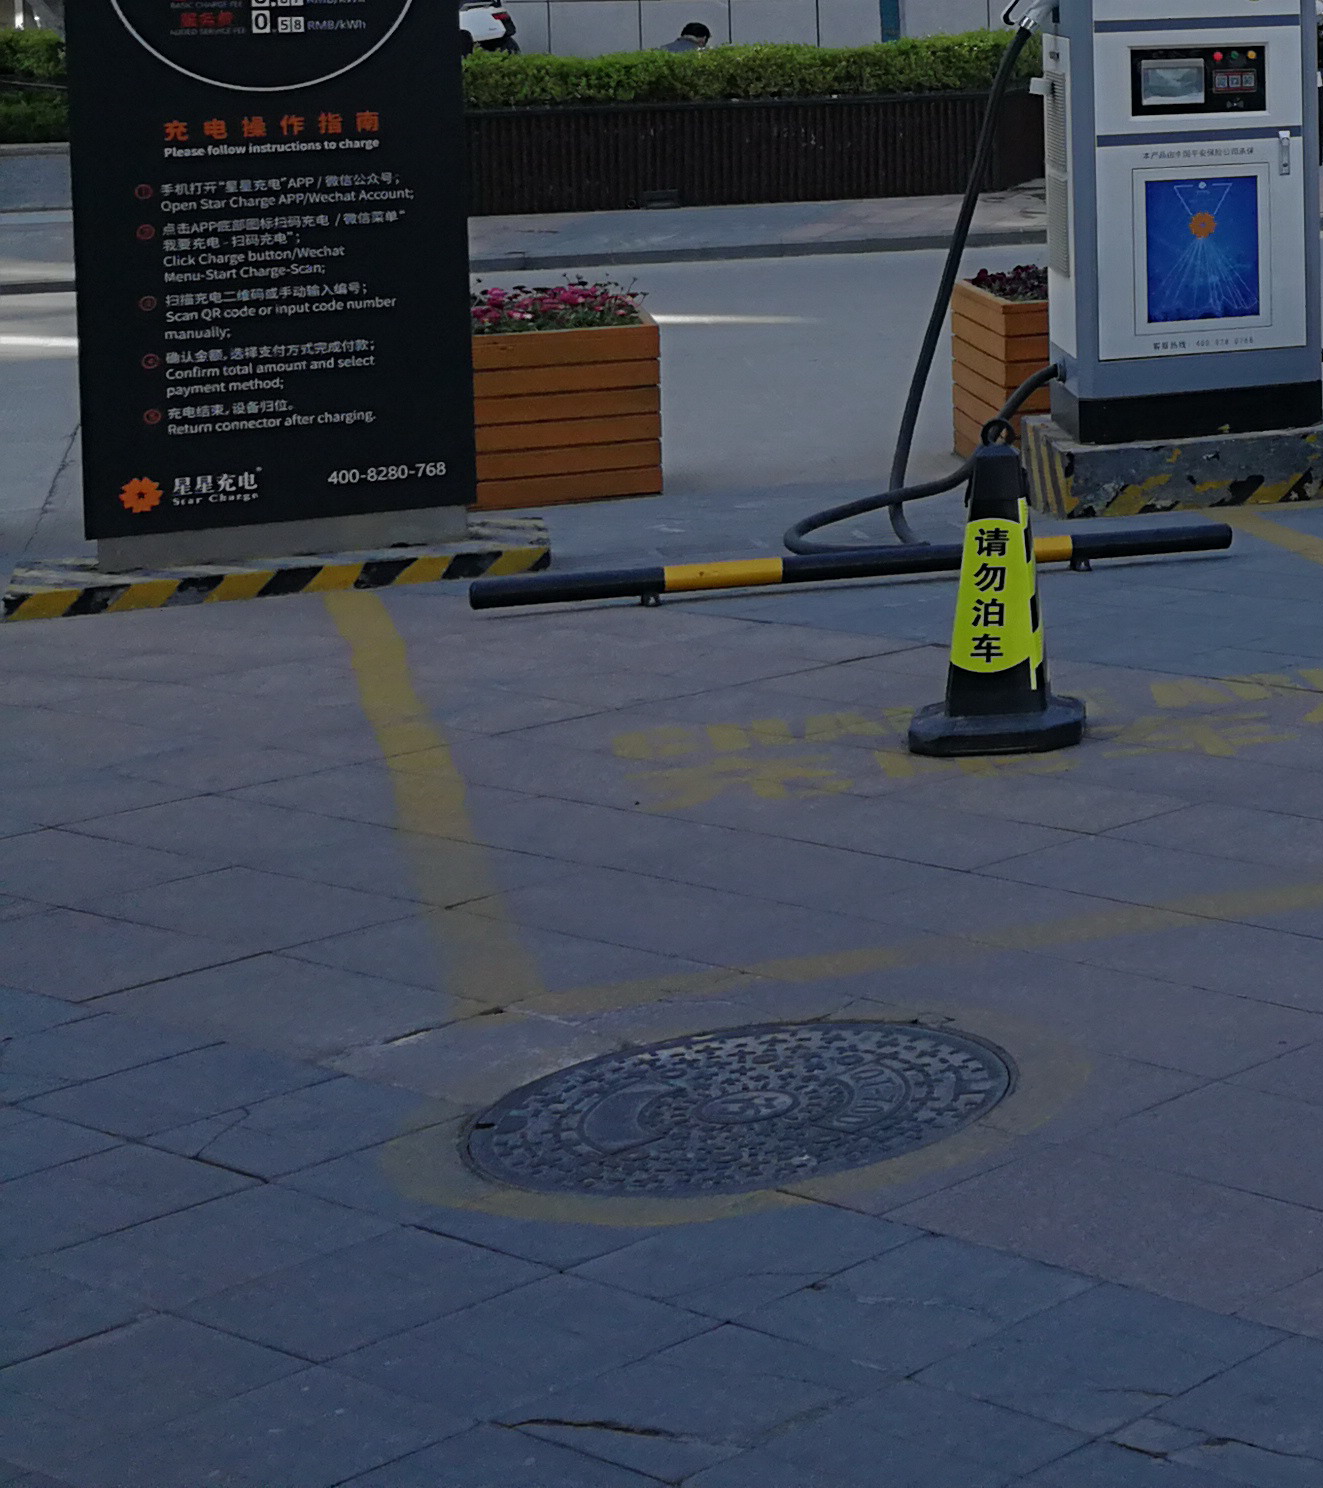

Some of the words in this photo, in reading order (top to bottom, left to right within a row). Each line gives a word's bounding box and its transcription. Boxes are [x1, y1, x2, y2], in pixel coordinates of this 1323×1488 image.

[307, 19, 366, 30] RMB/kWh
[163, 110, 380, 142] 充电操作指南
[164, 147, 205, 158] Please
[207, 144, 246, 155] follow
[249, 140, 322, 154] instructions
[324, 141, 337, 150] to
[339, 139, 380, 150] charge
[161, 199, 198, 213] Open
[200, 197, 227, 210] Star
[229, 195, 276, 209] Charge
[278, 190, 356, 206] APP/Wechat
[358, 188, 415, 202] Account;
[163, 254, 196, 267] Click
[198, 252, 246, 265] Charge
[247, 245, 345, 262] button/Wechat
[164, 268, 237, 283] Menu-Start
[239, 263, 326, 279] Charge-Scan;
[165, 311, 199, 323] Scan
[201, 307, 221, 321] QR
[223, 305, 256, 317] code
[258, 306, 273, 316] or
[275, 303, 310, 316] input
[312, 298, 344, 311] code
[346, 296, 397, 309] number
[164, 326, 232, 340] manually;
[165, 366, 220, 380] Confirm
[222, 362, 253, 376] total
[255, 360, 308, 374] amount
[309, 357, 335, 370] and
[337, 354, 376, 369] select
[166, 382, 227, 398] payment
[228, 377, 284, 391] method;
[167, 422, 213, 435] Return
[215, 417, 283, 432] connector
[284, 413, 316, 426] after
[317, 410, 377, 424] charging.
[173, 471, 258, 496] 星星充电
[327, 461, 447, 485] 400-8280-768
[172, 496, 202, 506] Star
[208, 492, 259, 504] Charge
[970, 527, 1010, 663] 请勿泊车
